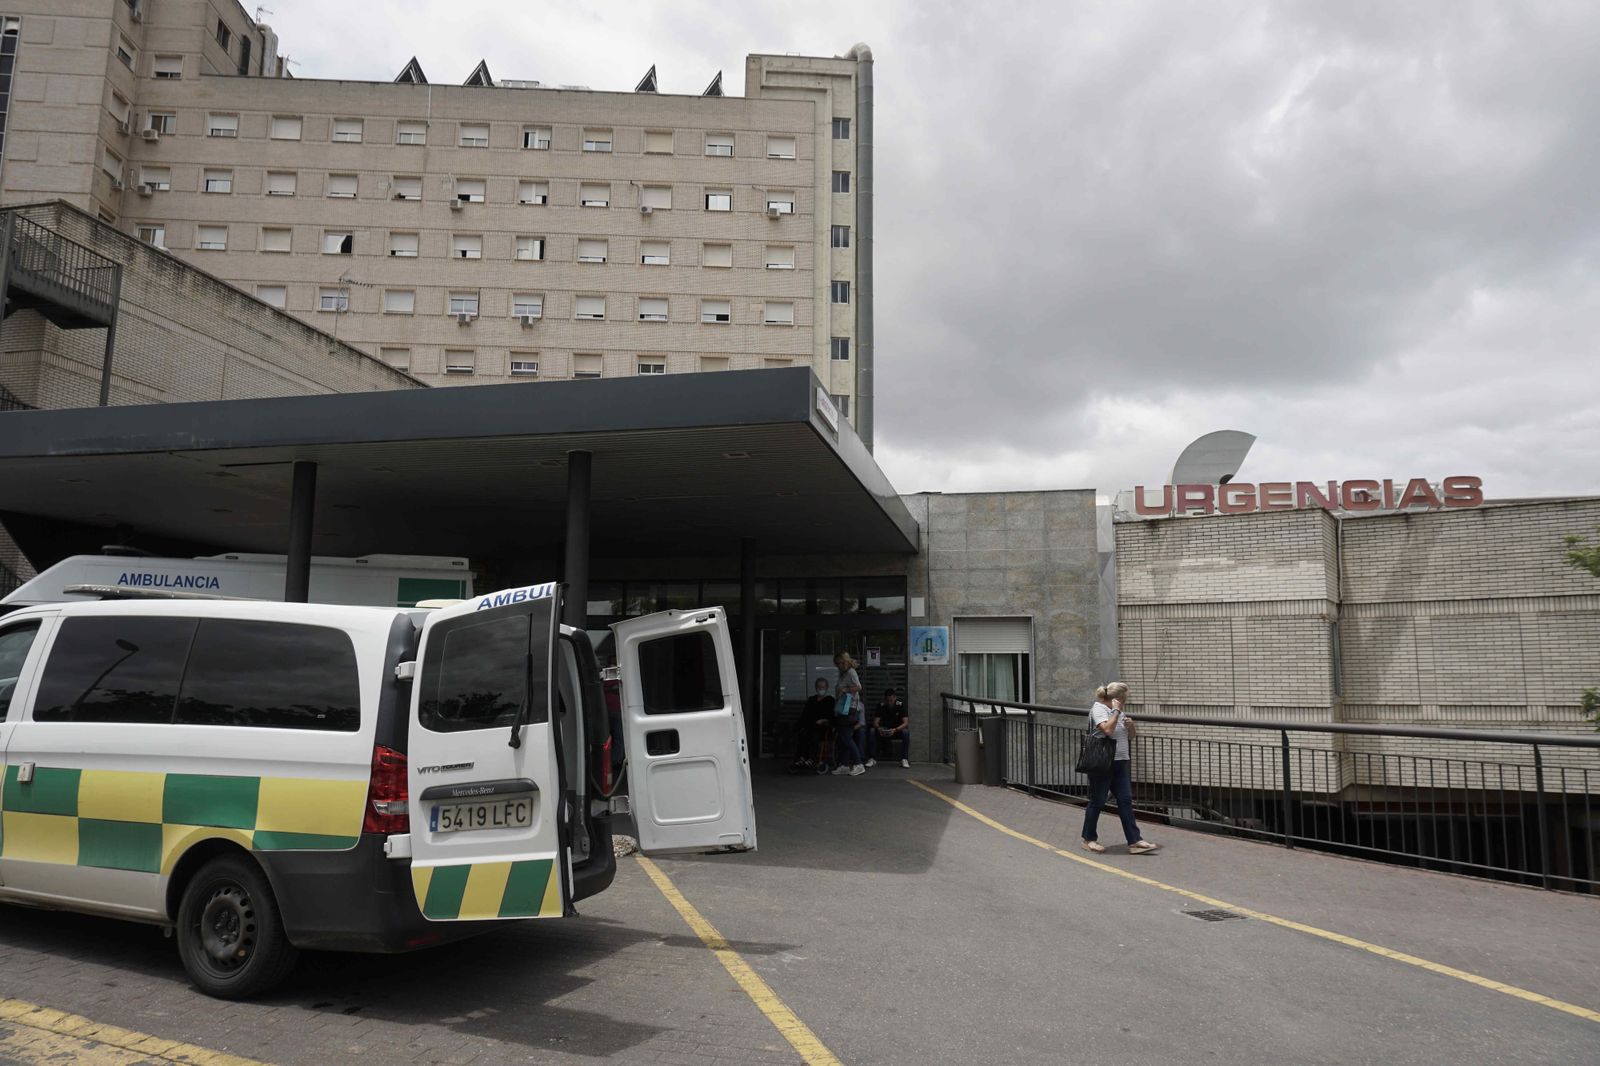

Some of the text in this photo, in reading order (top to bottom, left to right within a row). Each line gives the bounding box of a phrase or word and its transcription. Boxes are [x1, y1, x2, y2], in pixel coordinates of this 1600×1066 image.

[1135, 476, 1483, 515] URGENCIAS
[118, 573, 219, 589] AMBULANCIA
[417, 762, 473, 774] VITO TOURER
[452, 787, 495, 796] Mercedes-Benz
[442, 803, 526, 828] 5419 LFC
